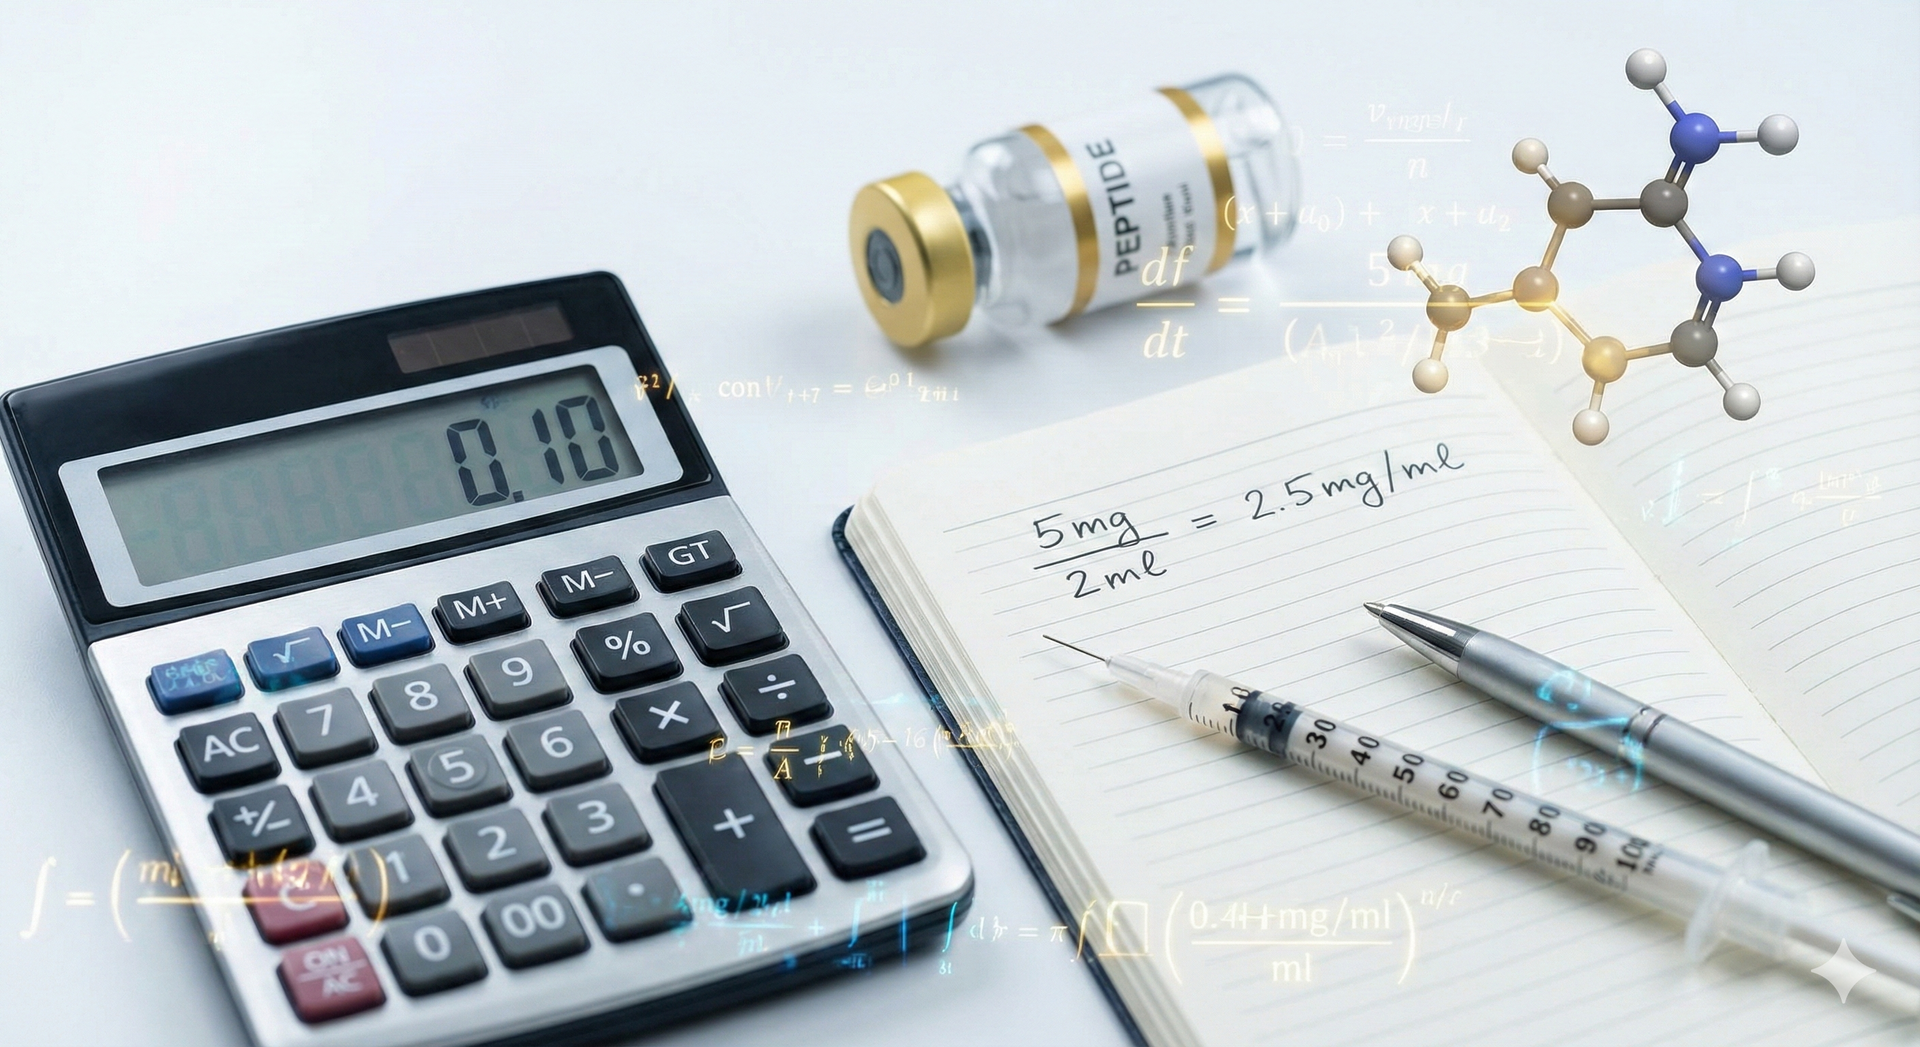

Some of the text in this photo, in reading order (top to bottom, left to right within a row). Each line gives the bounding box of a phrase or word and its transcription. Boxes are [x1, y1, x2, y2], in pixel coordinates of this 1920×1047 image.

[1085, 138, 1141, 277] PEPTIDE
[447, 395, 619, 506] 0.10
[667, 540, 710, 566] GT
[453, 593, 506, 620] M+
[501, 657, 533, 687] 9
[404, 680, 439, 711] 8
[306, 703, 333, 736] 7
[1306, 719, 1337, 749] 30
[203, 727, 260, 762] AC
[540, 725, 574, 759] 6
[1351, 736, 1380, 765] 40
[439, 750, 475, 784] 5
[1393, 753, 1424, 784] 50
[346, 775, 379, 807] 4
[1438, 770, 1469, 800] 60
[578, 800, 615, 834] 3
[1481, 788, 1514, 818] 70
[1529, 805, 1561, 836] 80
[477, 825, 517, 861] 2
[1575, 822, 1607, 854] 90
[386, 850, 410, 883] 1
[1616, 837, 1649, 872] 100
[501, 895, 566, 938] 00
[414, 925, 451, 961] 0
